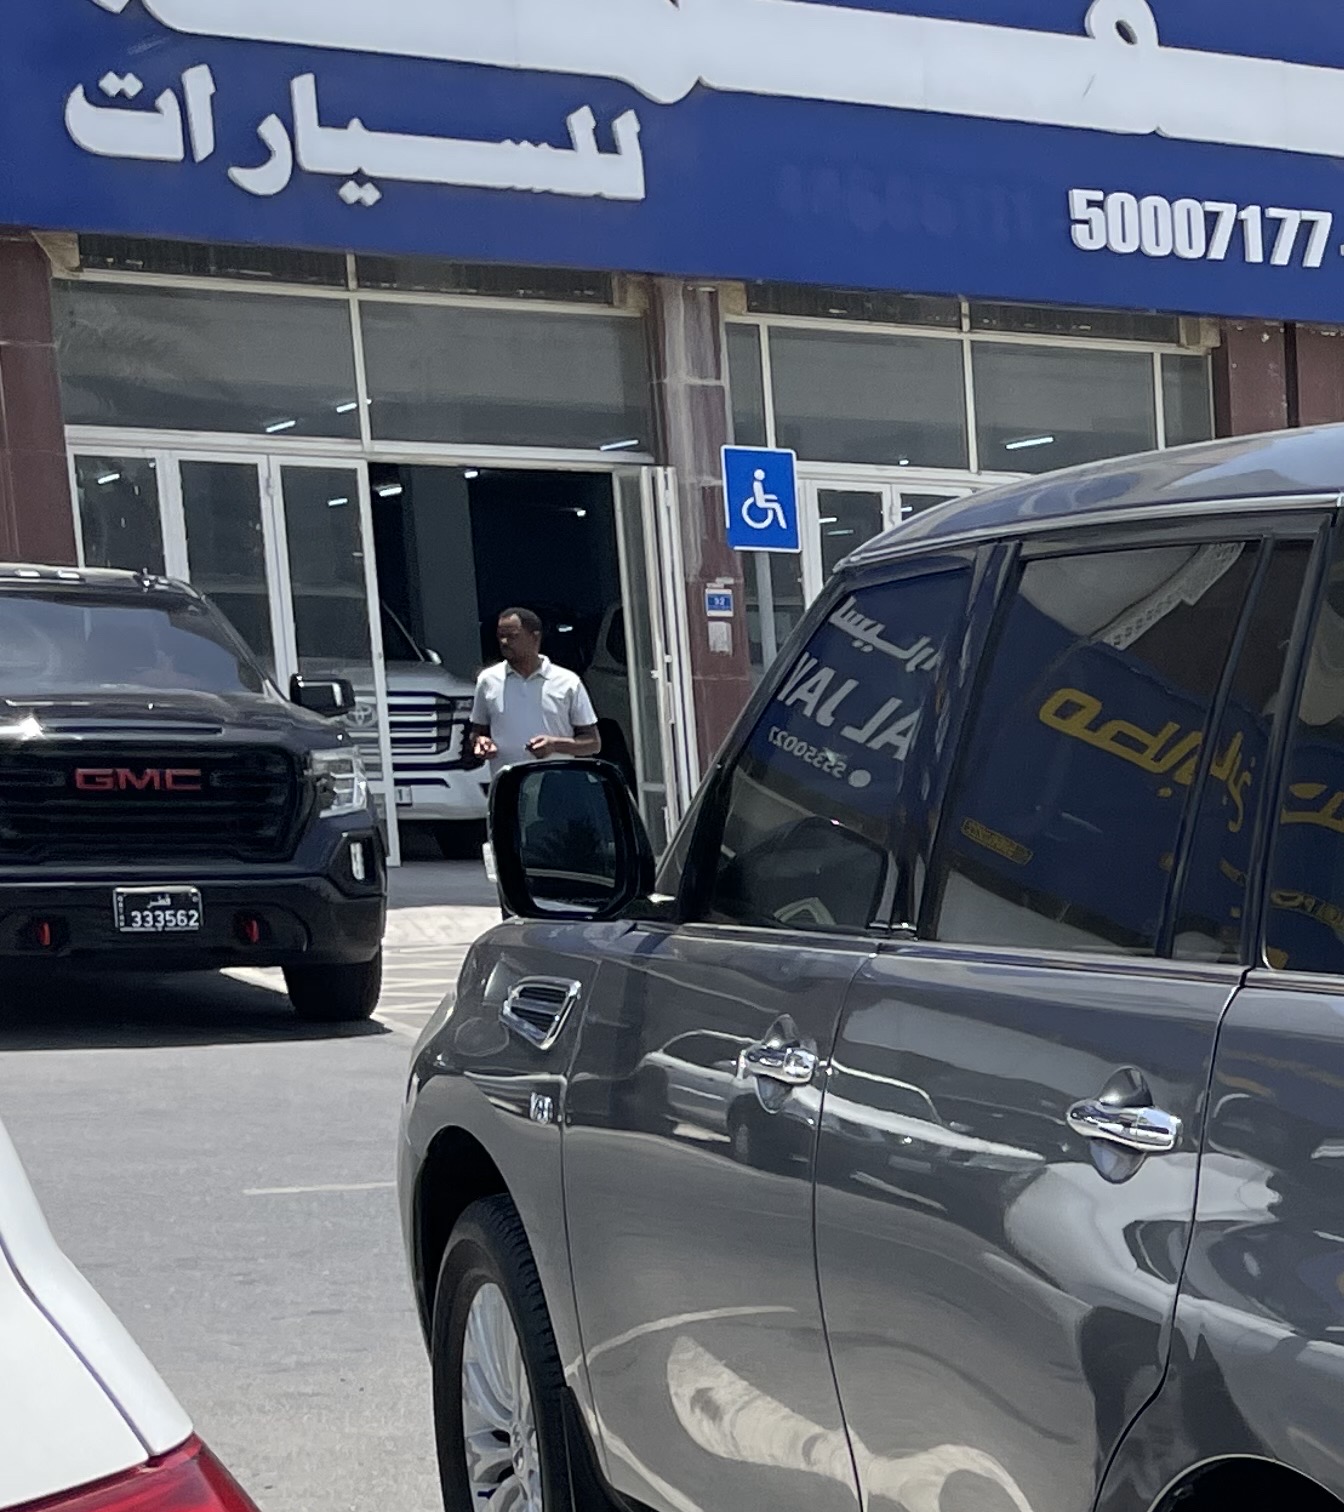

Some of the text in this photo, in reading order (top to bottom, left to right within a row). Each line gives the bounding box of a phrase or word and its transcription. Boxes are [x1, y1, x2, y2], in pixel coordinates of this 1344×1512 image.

[64, 63, 646, 206] للسيارات
[1068, 188, 1333, 269] 50007177
[74, 767, 202, 791] GMC
[130, 909, 200, 928] 333562
